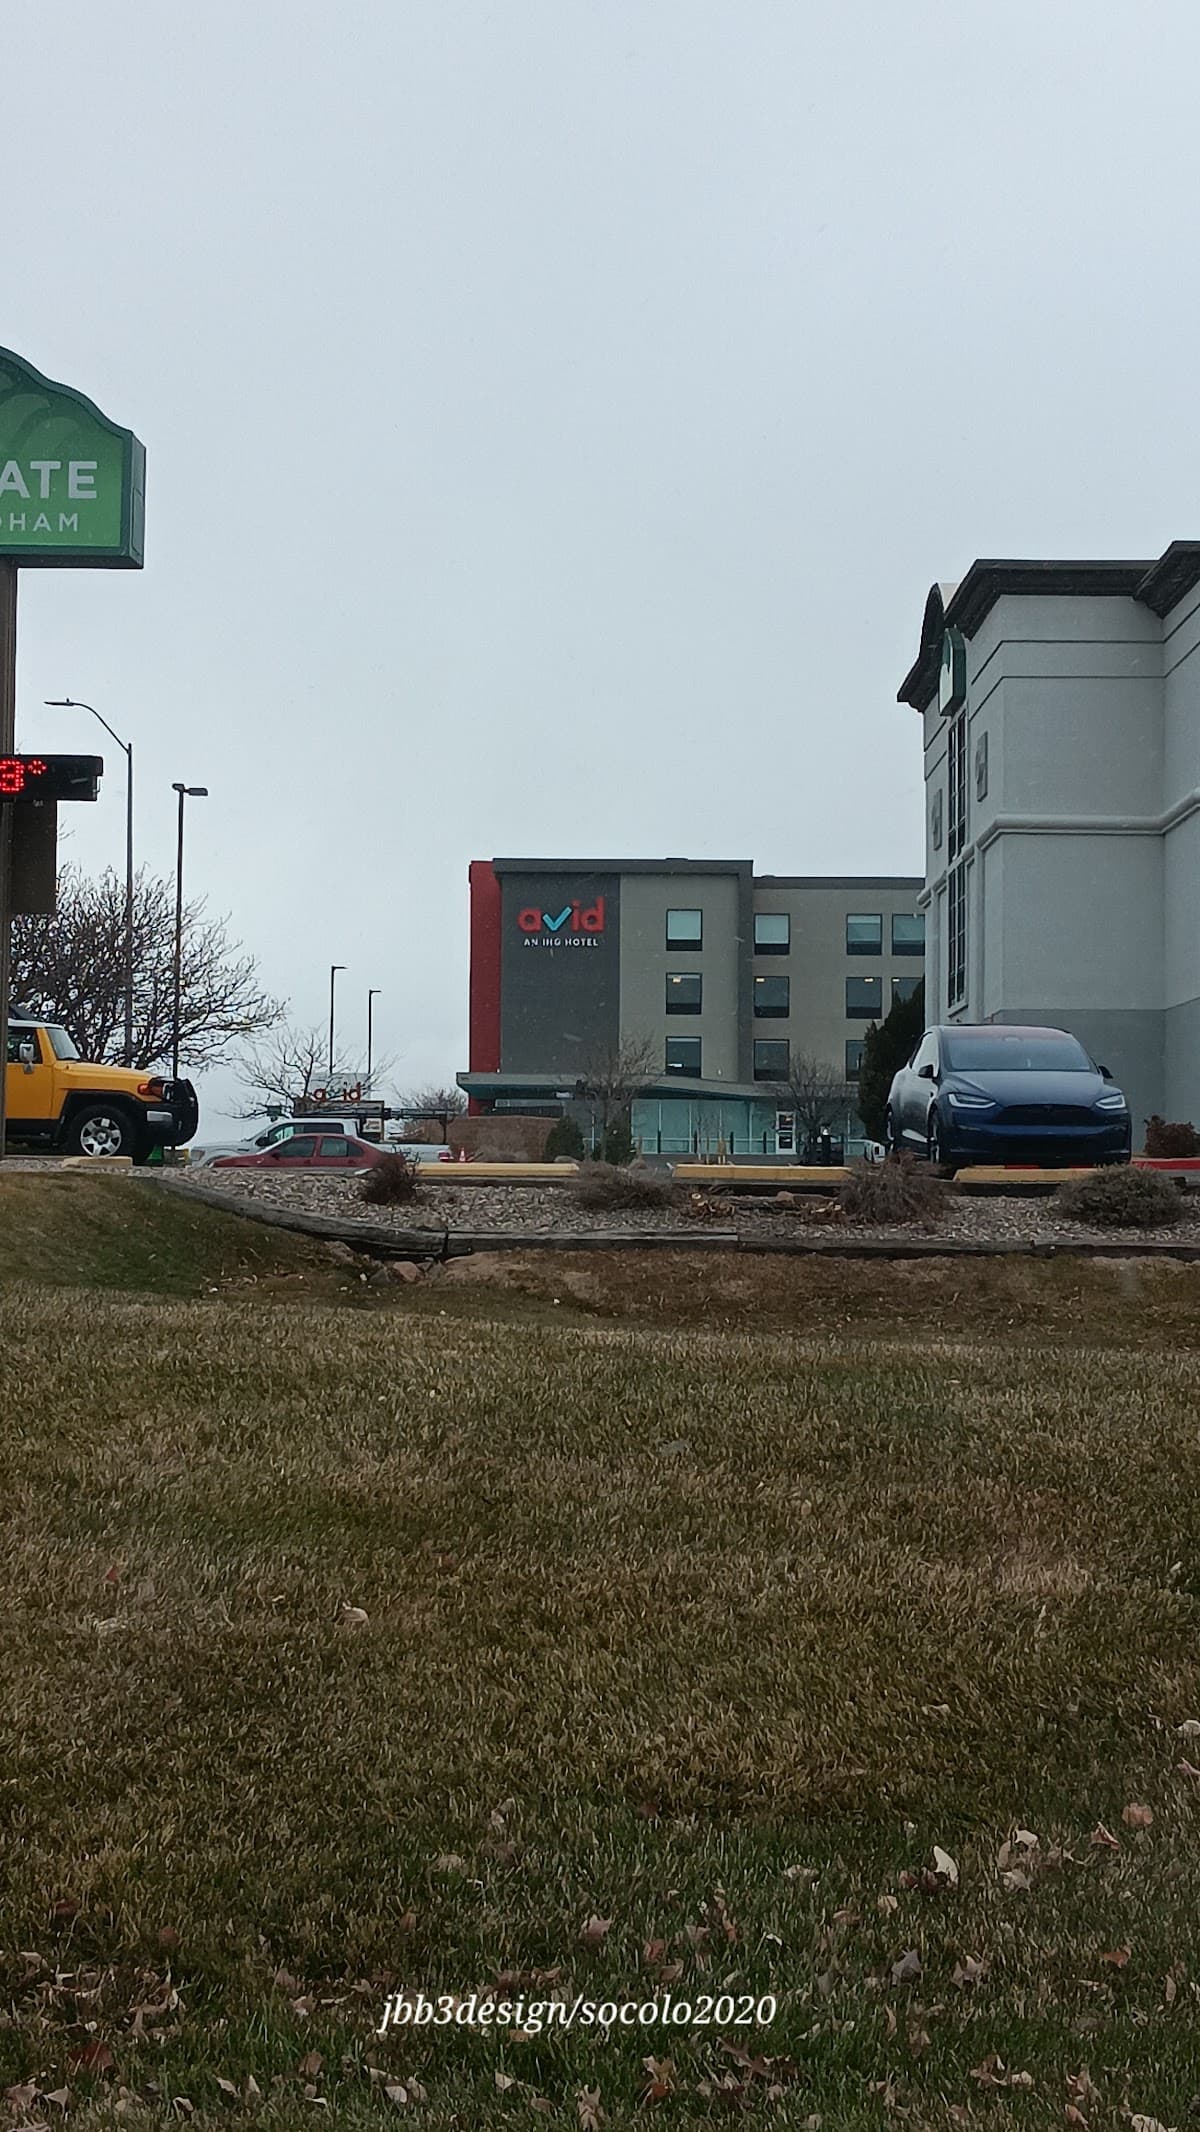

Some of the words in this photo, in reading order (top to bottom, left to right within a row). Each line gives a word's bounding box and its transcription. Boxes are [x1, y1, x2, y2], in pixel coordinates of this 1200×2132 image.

[0, 460, 98, 499] ATE
[0, 512, 79, 532] HAM
[517, 895, 605, 933] avid
[523, 938, 539, 947] AN
[542, 938, 561, 947] IHG
[564, 938, 599, 947] HOTEL
